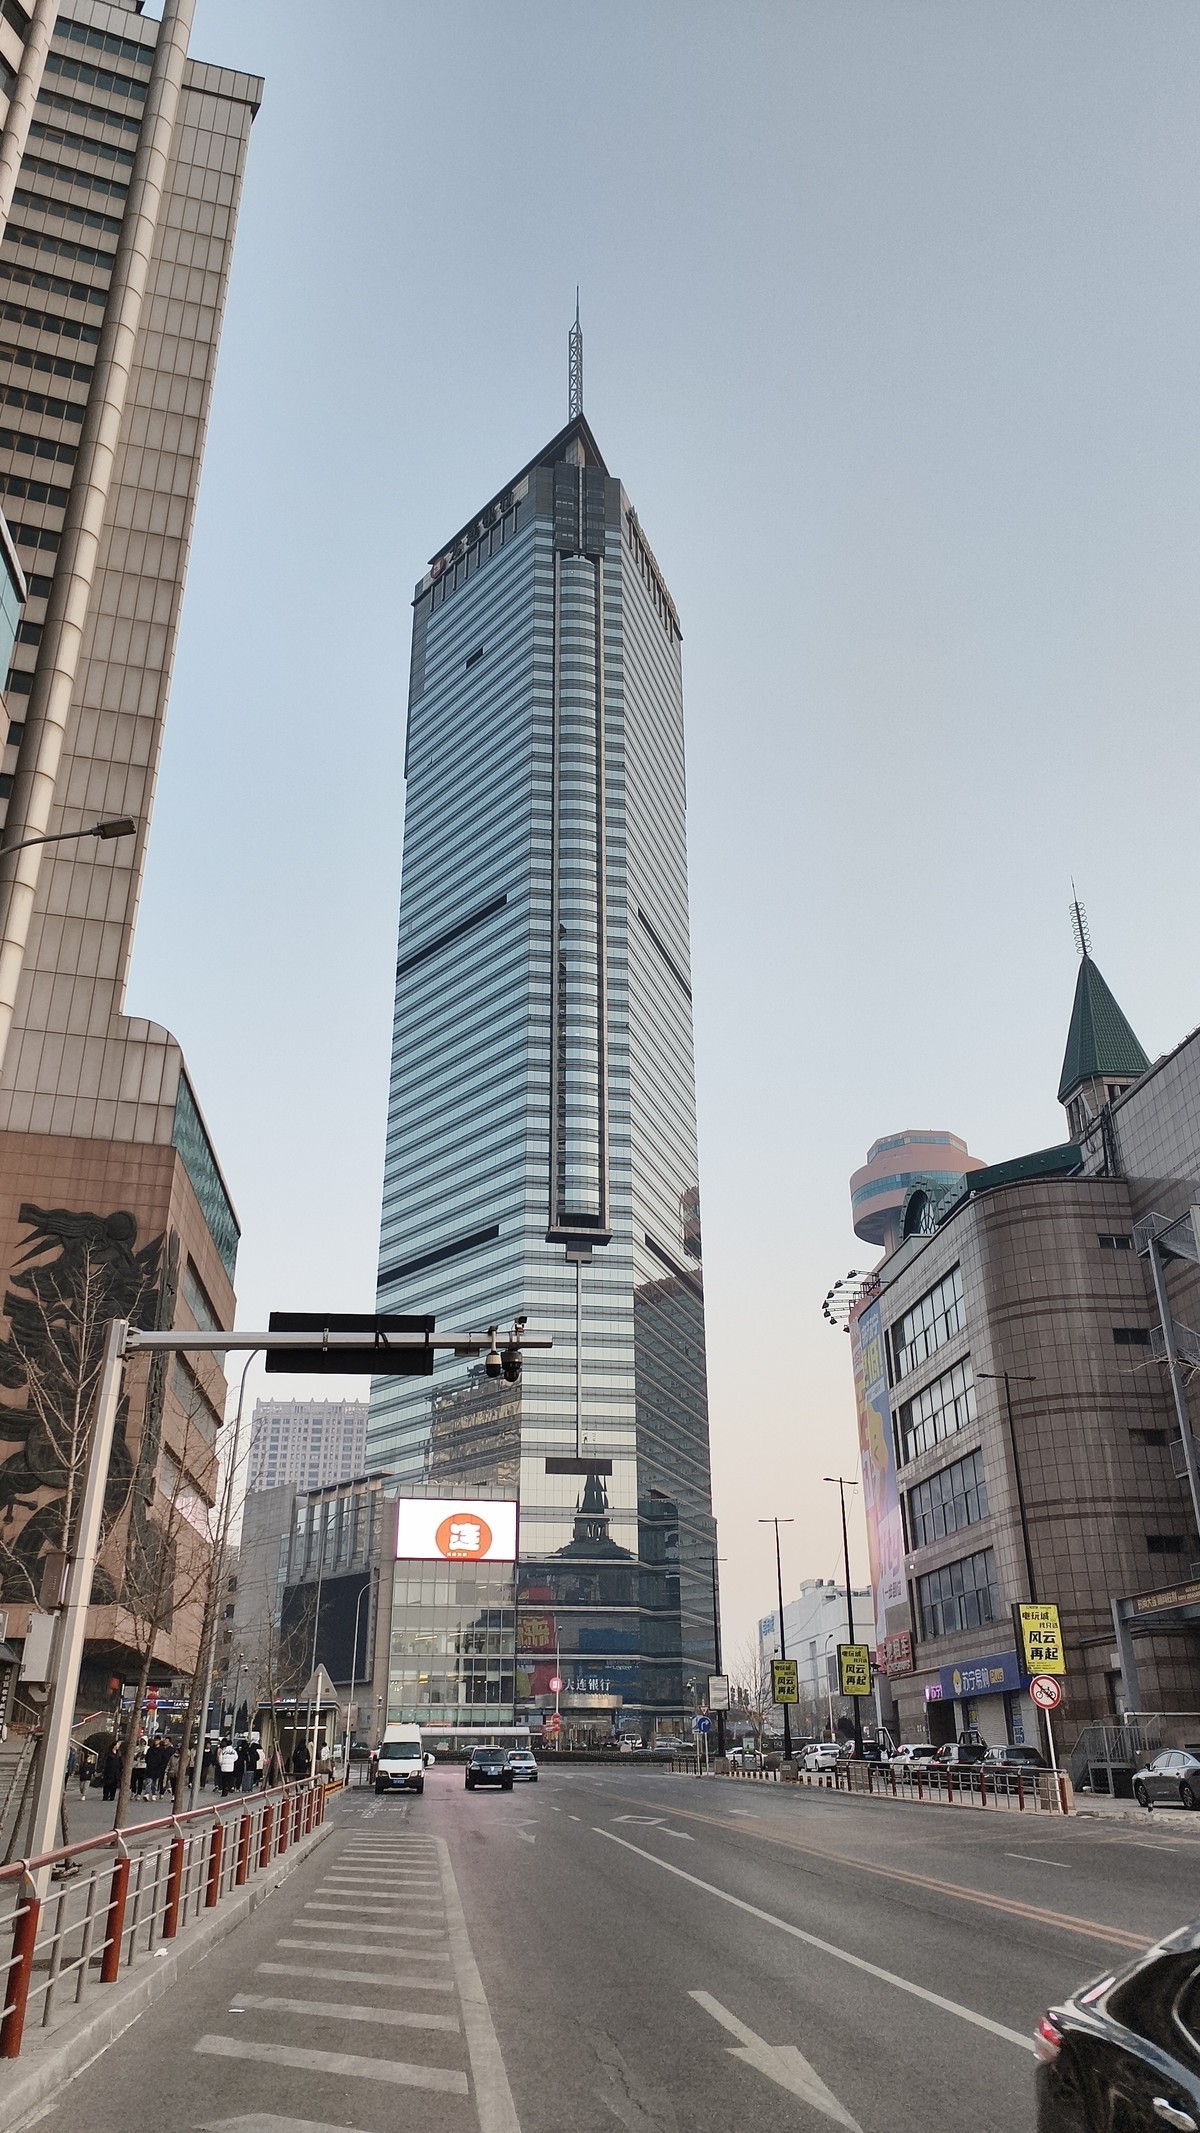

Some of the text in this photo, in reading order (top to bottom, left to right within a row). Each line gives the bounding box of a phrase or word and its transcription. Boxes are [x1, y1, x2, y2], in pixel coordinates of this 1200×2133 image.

[1022, 1611, 1050, 1621] 电玩城
[1029, 1630, 1056, 1644] 风云
[1030, 1647, 1059, 1660] 再起
[845, 1664, 865, 1674] 风云
[564, 1677, 611, 1692] 大连银行
[778, 1676, 794, 1685] 风云
[846, 1675, 867, 1686] 再起
[962, 1667, 990, 1691] 苏宁易购
